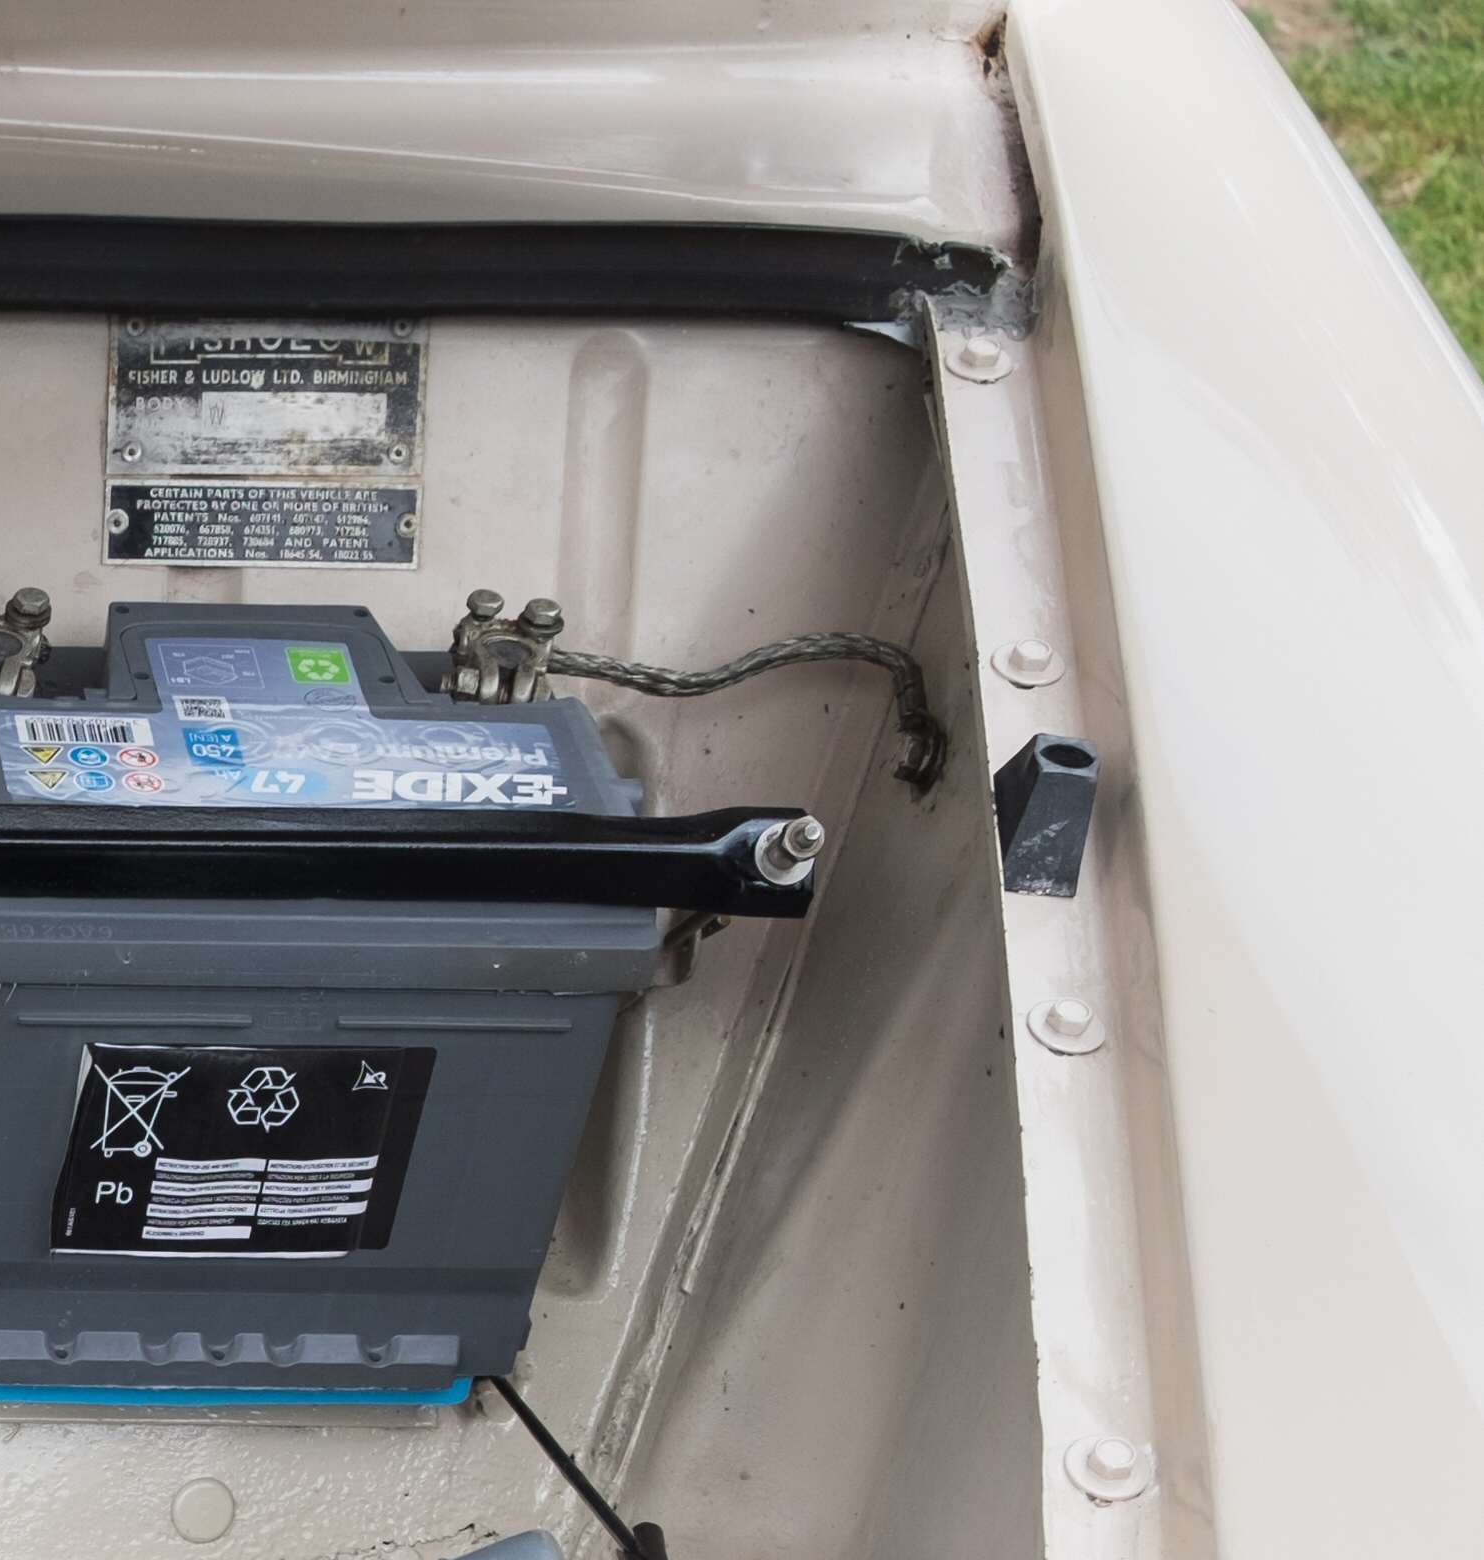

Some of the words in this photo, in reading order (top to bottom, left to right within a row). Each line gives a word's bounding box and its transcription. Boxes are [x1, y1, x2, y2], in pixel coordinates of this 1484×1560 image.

[129, 369, 178, 385] FISHER
[184, 370, 195, 384] &
[202, 369, 265, 389] LUDLOW
[273, 370, 304, 385] LTD.
[313, 370, 408, 386] BIRMINGHAM
[150, 487, 204, 500] CERTAIN
[207, 488, 245, 500] PARTS
[248, 488, 265, 501] OF
[268, 489, 297, 501] THIS
[301, 489, 352, 502] VEHICLE
[355, 490, 378, 502] ARE
[136, 499, 208, 512] PROTECTED
[211, 500, 228, 512] BY
[230, 500, 258, 513] ONE
[262, 500, 280, 513] OR
[283, 501, 319, 514] MORE
[322, 501, 340, 514] OF
[342, 502, 391, 515] BRITISH
[154, 511, 209, 523] PATENTS
[284, 536, 312, 549] AND
[322, 537, 370, 550] PATENT
[144, 547, 235, 559] APPLICATIONS
[220, 733, 233, 743] A
[191, 743, 236, 758] 450
[376, 742, 548, 766] Premium
[214, 768, 243, 780] Ah
[250, 772, 308, 795] 47
[352, 769, 568, 806] EXIDE
[95, 1181, 134, 1205] Pb
